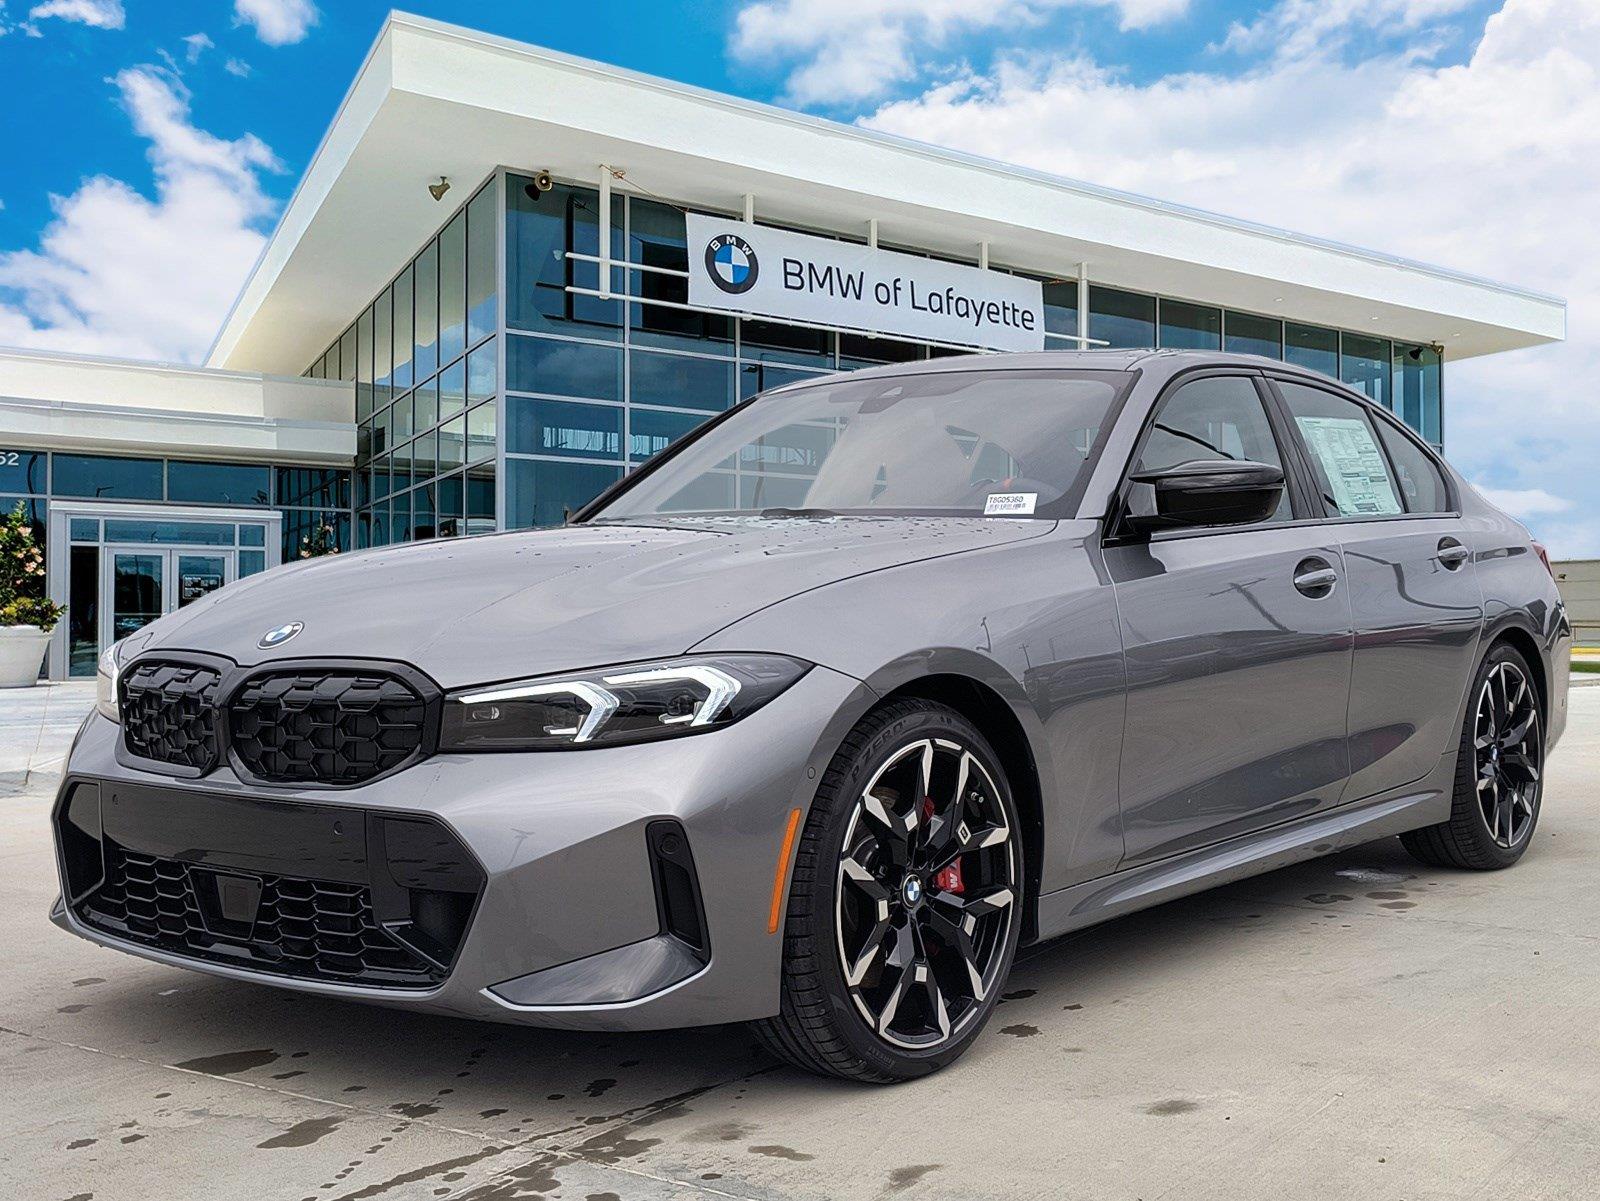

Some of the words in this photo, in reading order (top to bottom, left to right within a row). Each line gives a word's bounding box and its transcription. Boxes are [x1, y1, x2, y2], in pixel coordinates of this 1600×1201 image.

[710, 236, 752, 257] BMW
[783, 257, 864, 301] BMW
[875, 278, 902, 305] of
[911, 281, 1035, 332] Lafayette
